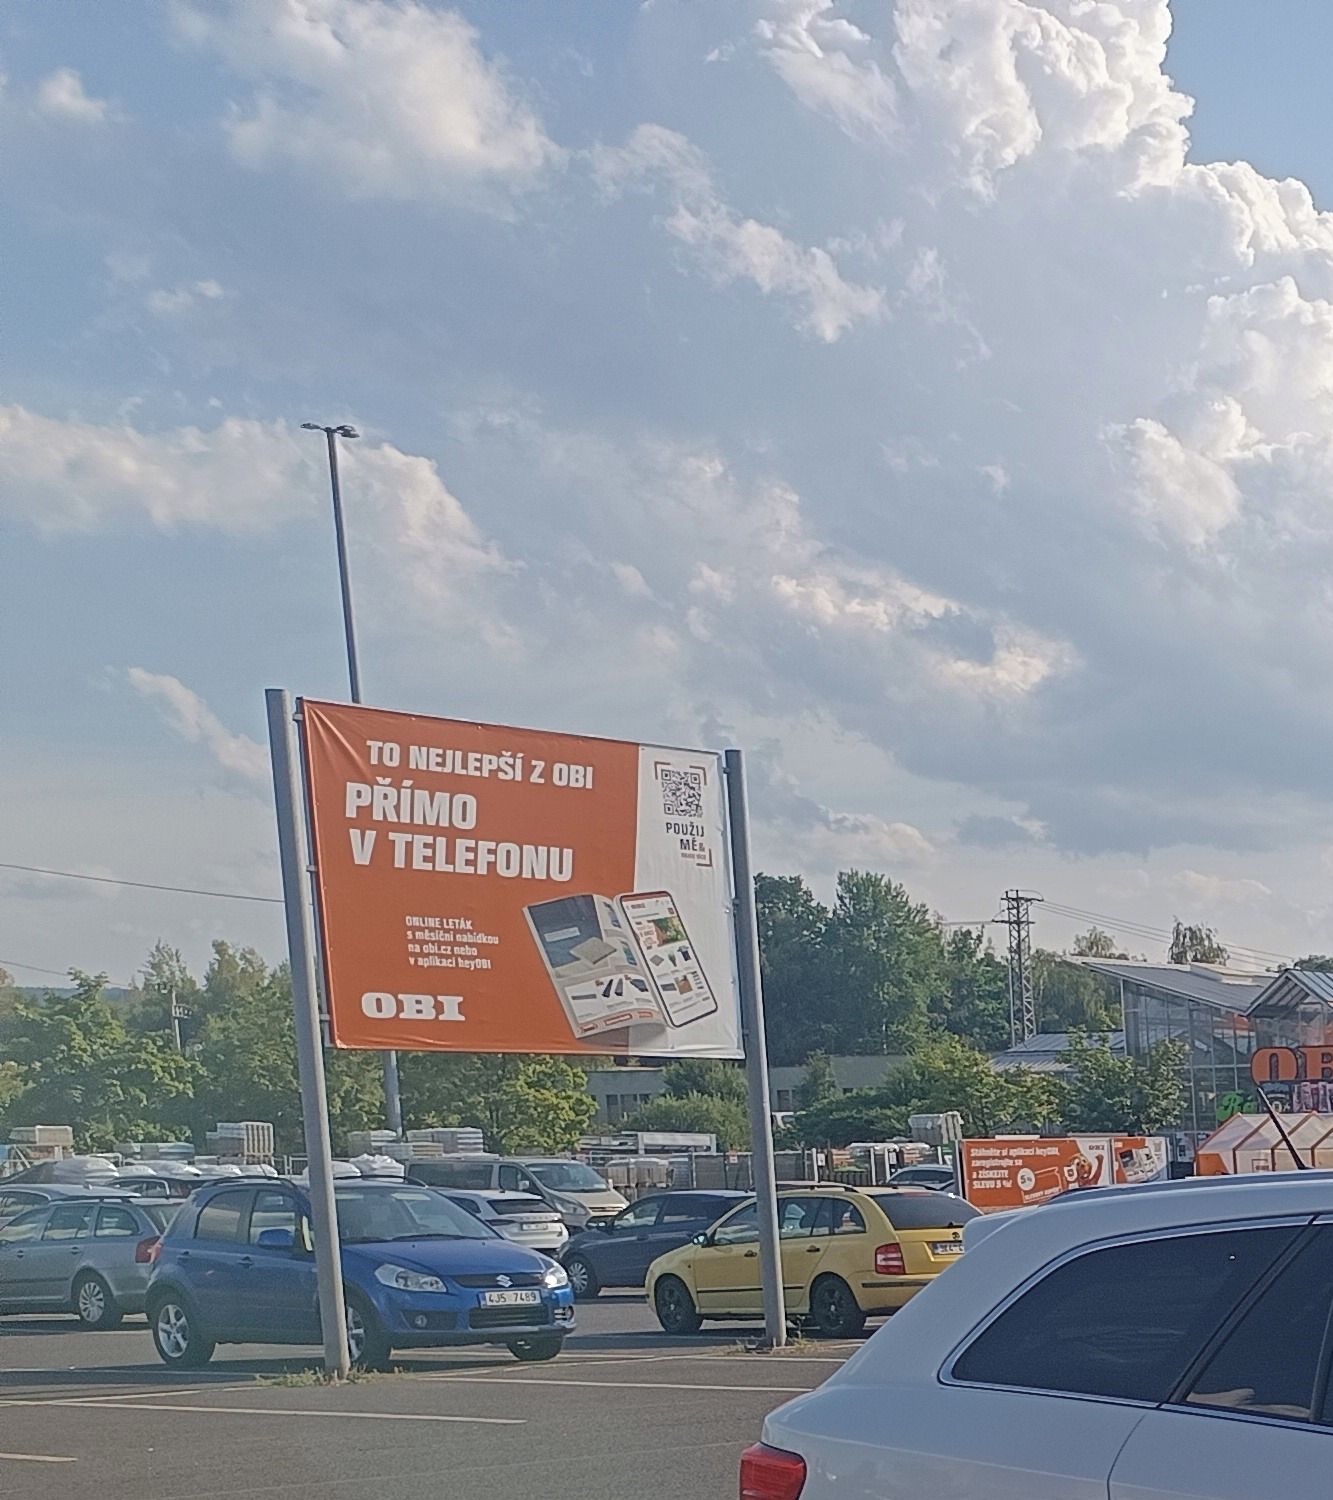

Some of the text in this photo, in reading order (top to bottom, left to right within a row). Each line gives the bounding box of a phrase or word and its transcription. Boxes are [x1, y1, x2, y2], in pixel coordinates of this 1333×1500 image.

[366, 740, 593, 789] TO NEJLEPŠÍ Z OBI
[345, 776, 477, 830] PŘÍMO
[665, 821, 705, 837] POUŽIJ
[349, 828, 573, 882] V TELEFONU
[405, 915, 473, 930] ONLINE LETÁK
[407, 943, 478, 956] na obi.cz nebo
[361, 992, 466, 1021] OBI
